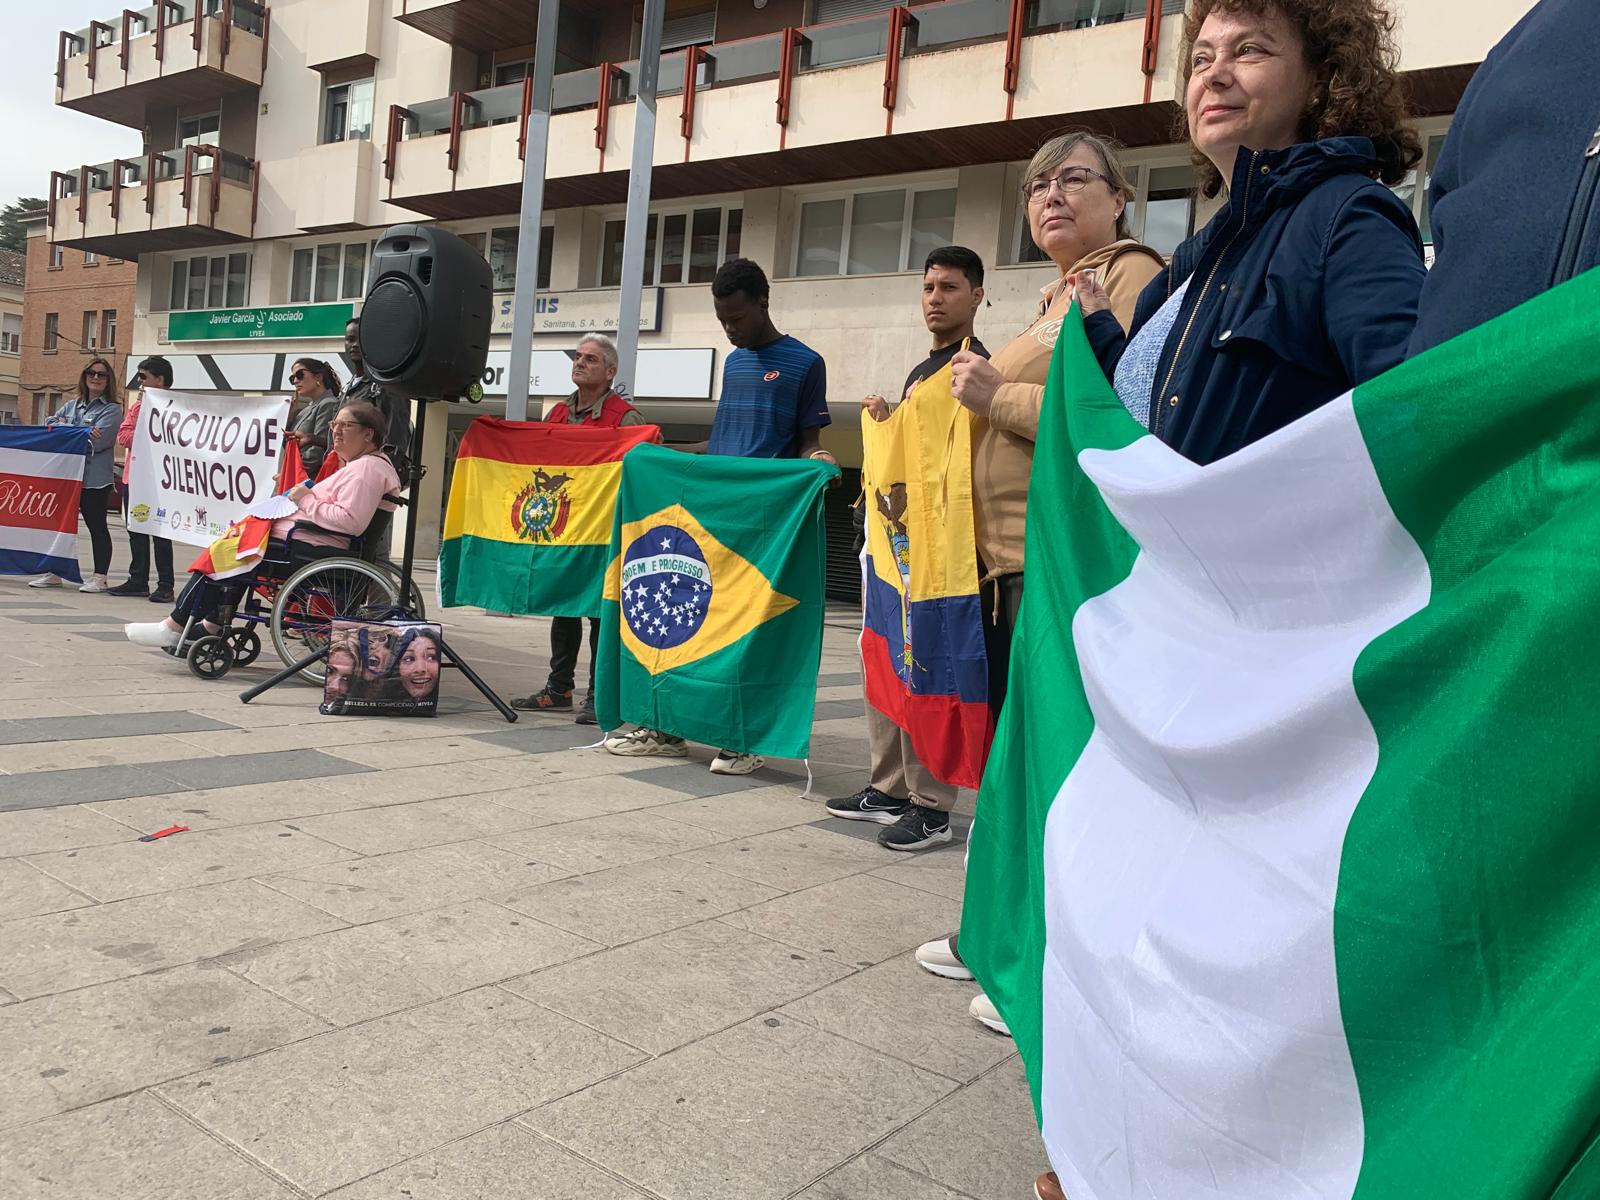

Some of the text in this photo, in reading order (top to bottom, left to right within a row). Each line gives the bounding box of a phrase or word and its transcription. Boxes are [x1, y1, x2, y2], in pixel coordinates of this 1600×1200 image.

[501, 298, 559, 315] SUS
[209, 314, 231, 324] Javier
[232, 312, 255, 323] García
[268, 311, 304, 322] Asociado
[603, 318, 613, 327] de
[149, 400, 277, 457] CÍRCULO DE
[161, 454, 256, 504] SILENCIO
[0, 480, 58, 518] Rica
[652, 560, 657, 571] E
